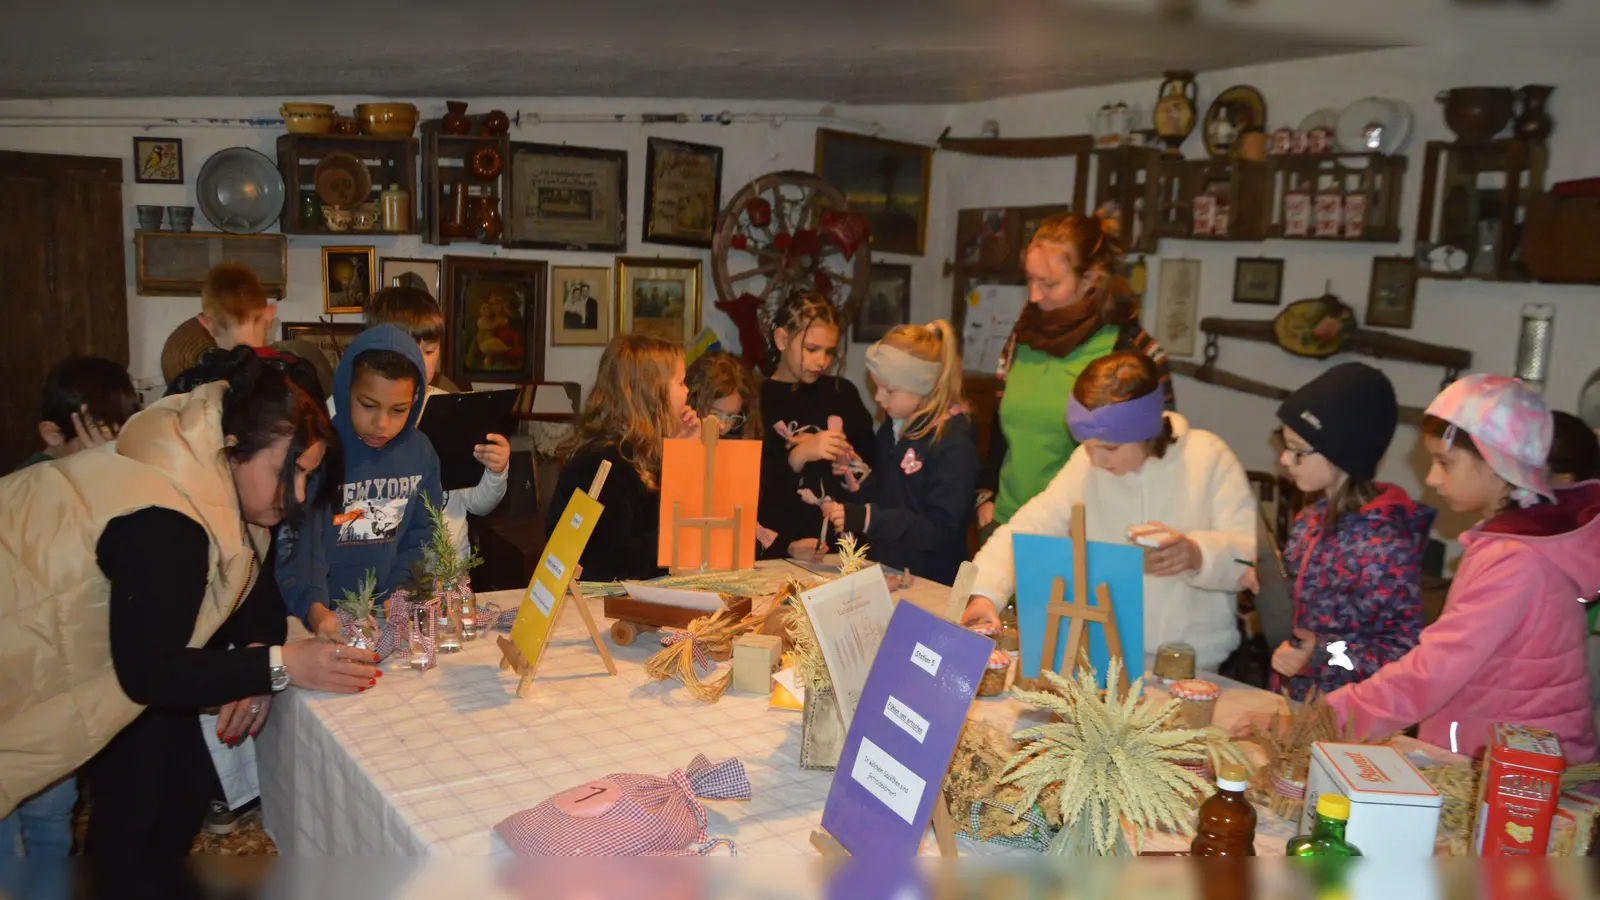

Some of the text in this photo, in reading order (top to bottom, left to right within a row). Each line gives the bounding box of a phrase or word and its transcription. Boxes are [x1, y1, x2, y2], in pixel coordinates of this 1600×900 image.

[373, 474, 423, 500] YORK
[914, 650, 931, 665] Station
[574, 786, 607, 803] 7
